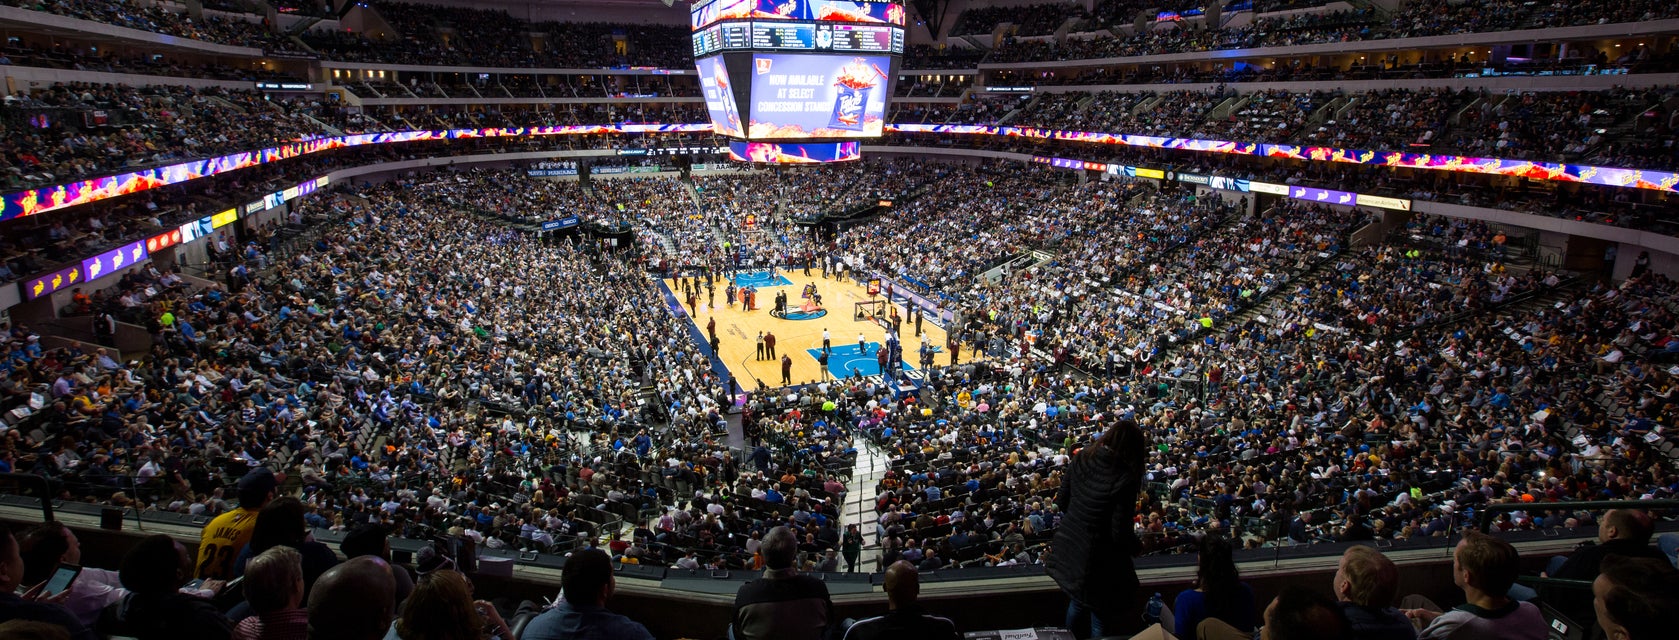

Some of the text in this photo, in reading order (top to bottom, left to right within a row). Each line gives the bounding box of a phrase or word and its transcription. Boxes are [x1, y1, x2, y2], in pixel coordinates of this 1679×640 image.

[769, 75, 824, 85] NOW AVAILABLE
[777, 88, 815, 99] AT SELECT
[758, 101, 803, 112] CONCESSION
[213, 526, 240, 541] JAMES
[200, 543, 234, 578] 23
